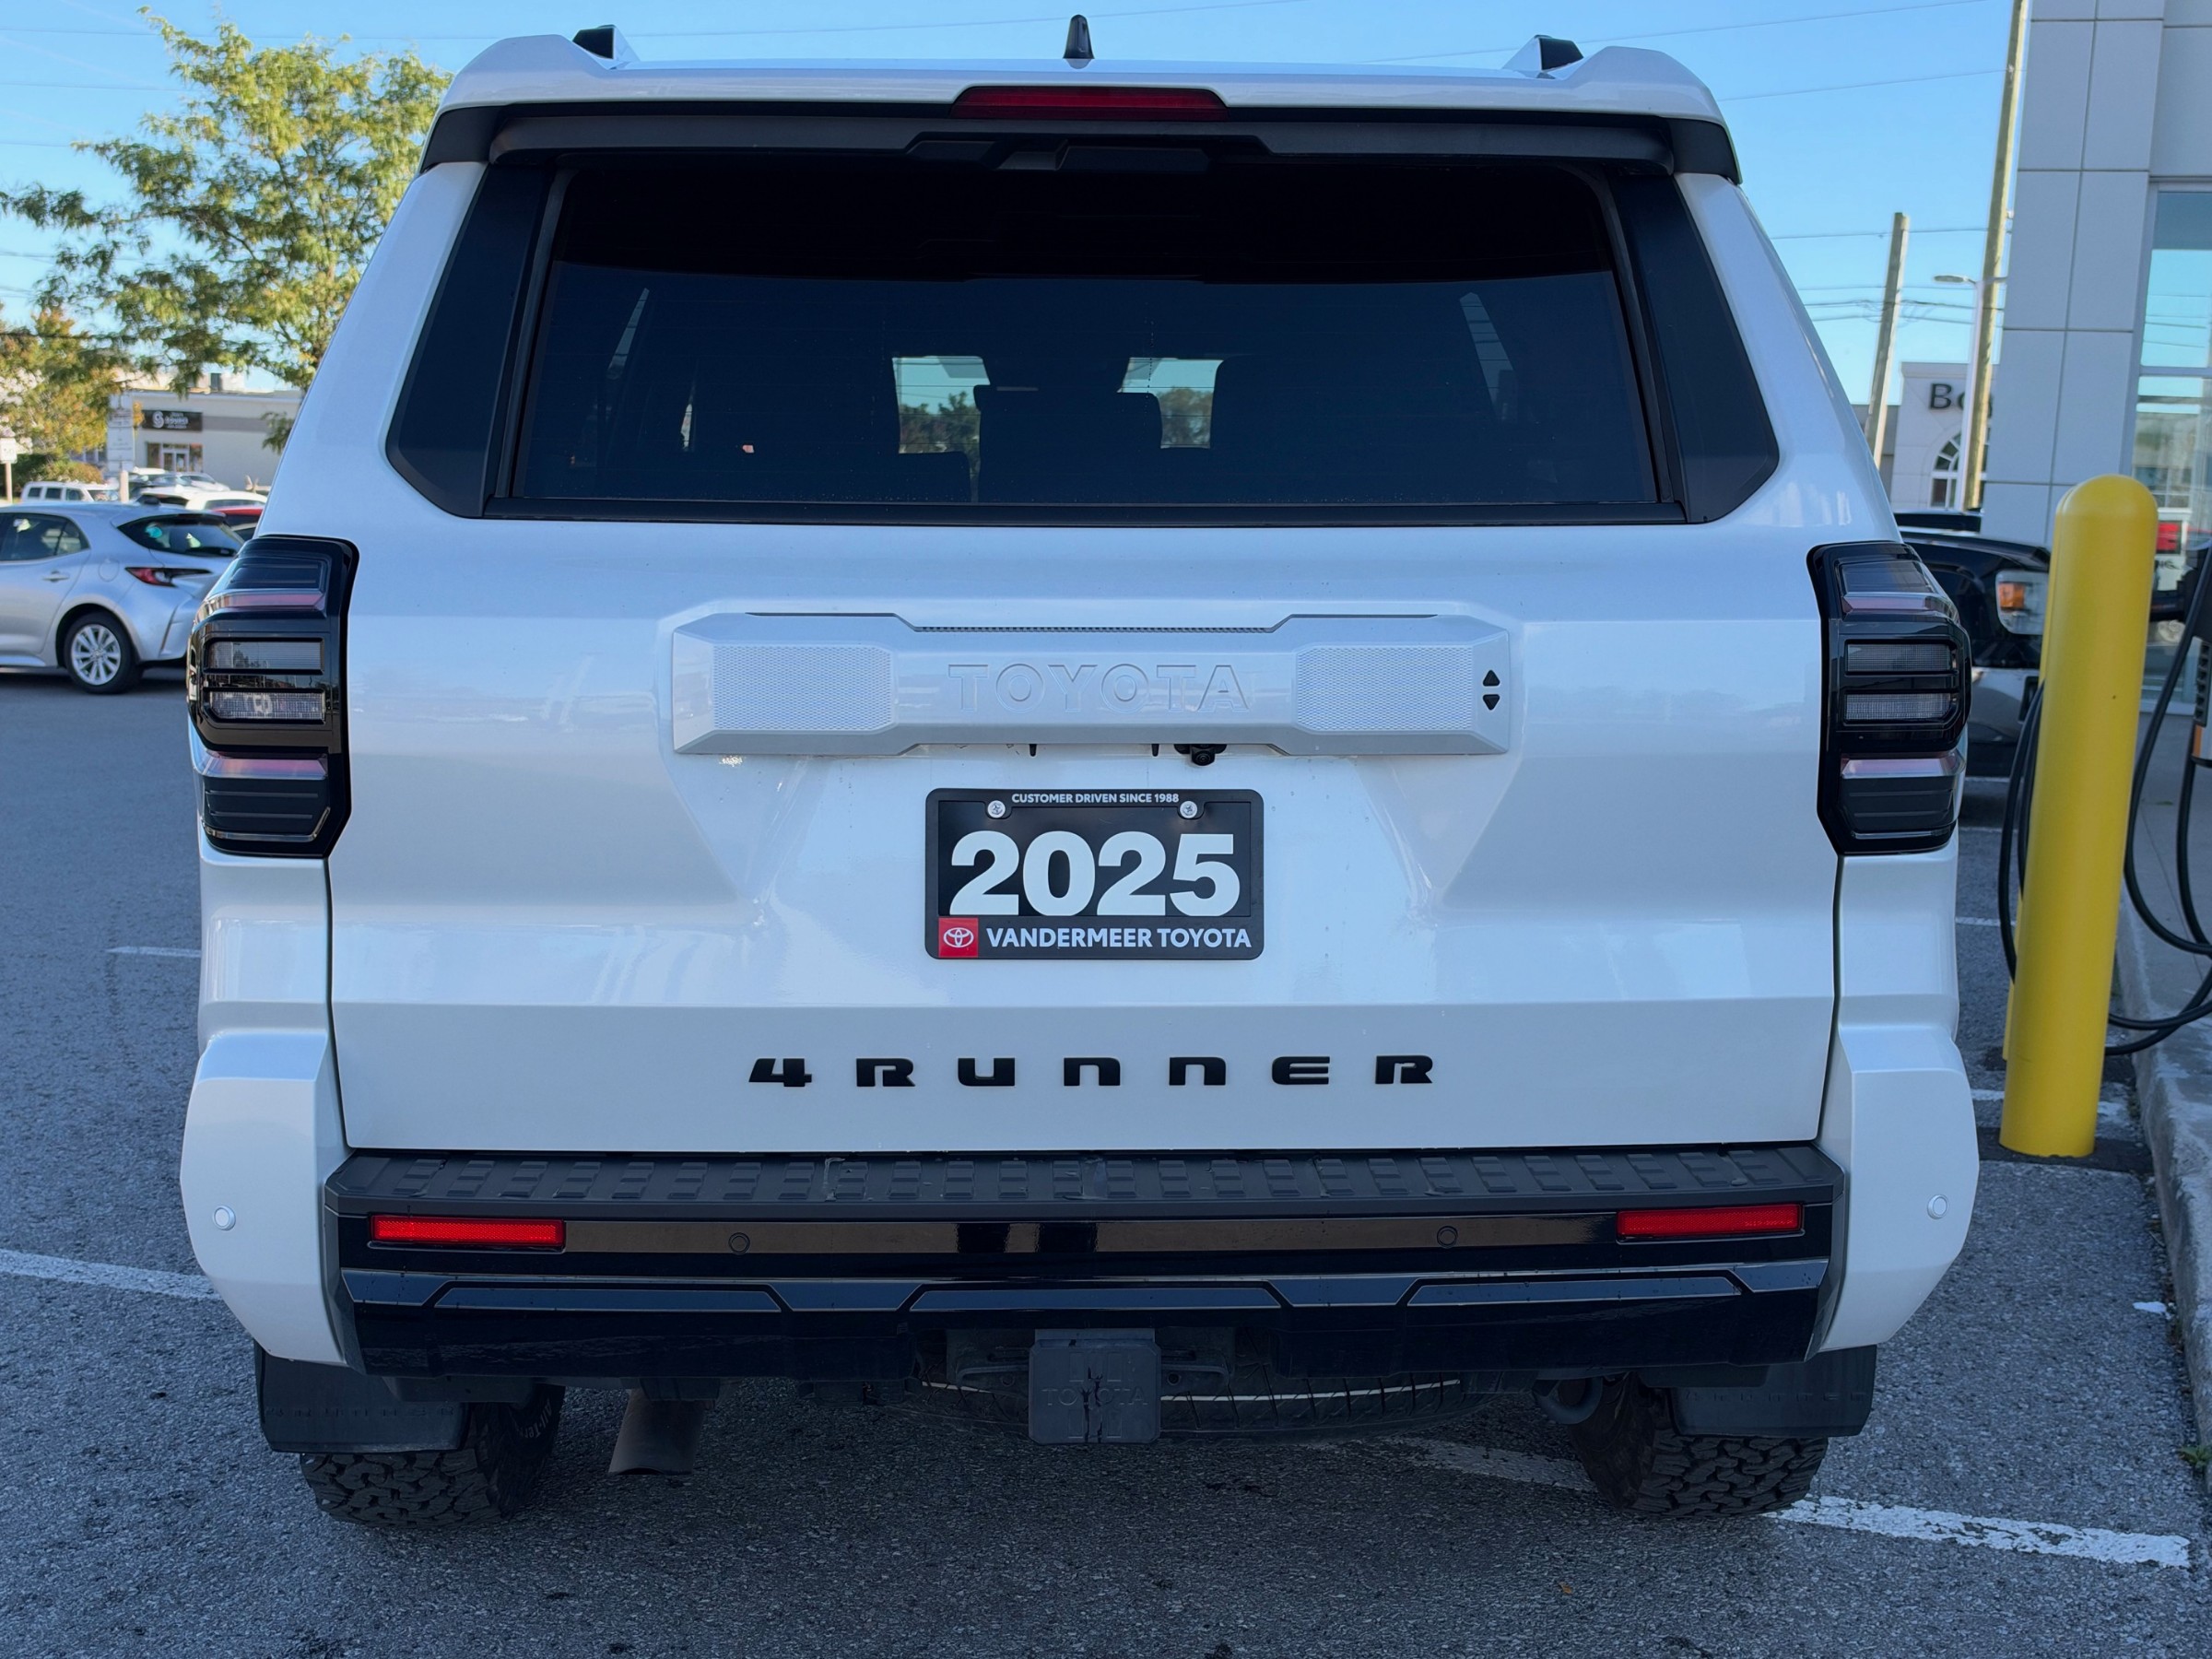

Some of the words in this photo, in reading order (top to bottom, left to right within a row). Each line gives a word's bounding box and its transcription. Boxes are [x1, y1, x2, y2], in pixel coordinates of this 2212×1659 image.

[947, 662, 1250, 713] TOYOTA
[1011, 793, 1074, 806] CUSTOMER
[1075, 793, 1118, 806] DRIVEN
[1119, 793, 1152, 806] SINCE
[1154, 793, 1180, 806] 1988
[949, 830, 1241, 916] 2025
[985, 927, 1153, 948] VANDERMEER
[1156, 927, 1253, 948] TOYOTA
[747, 1054, 1434, 1088] 4RUNNER
[1041, 1386, 1149, 1407] TOYOTA
